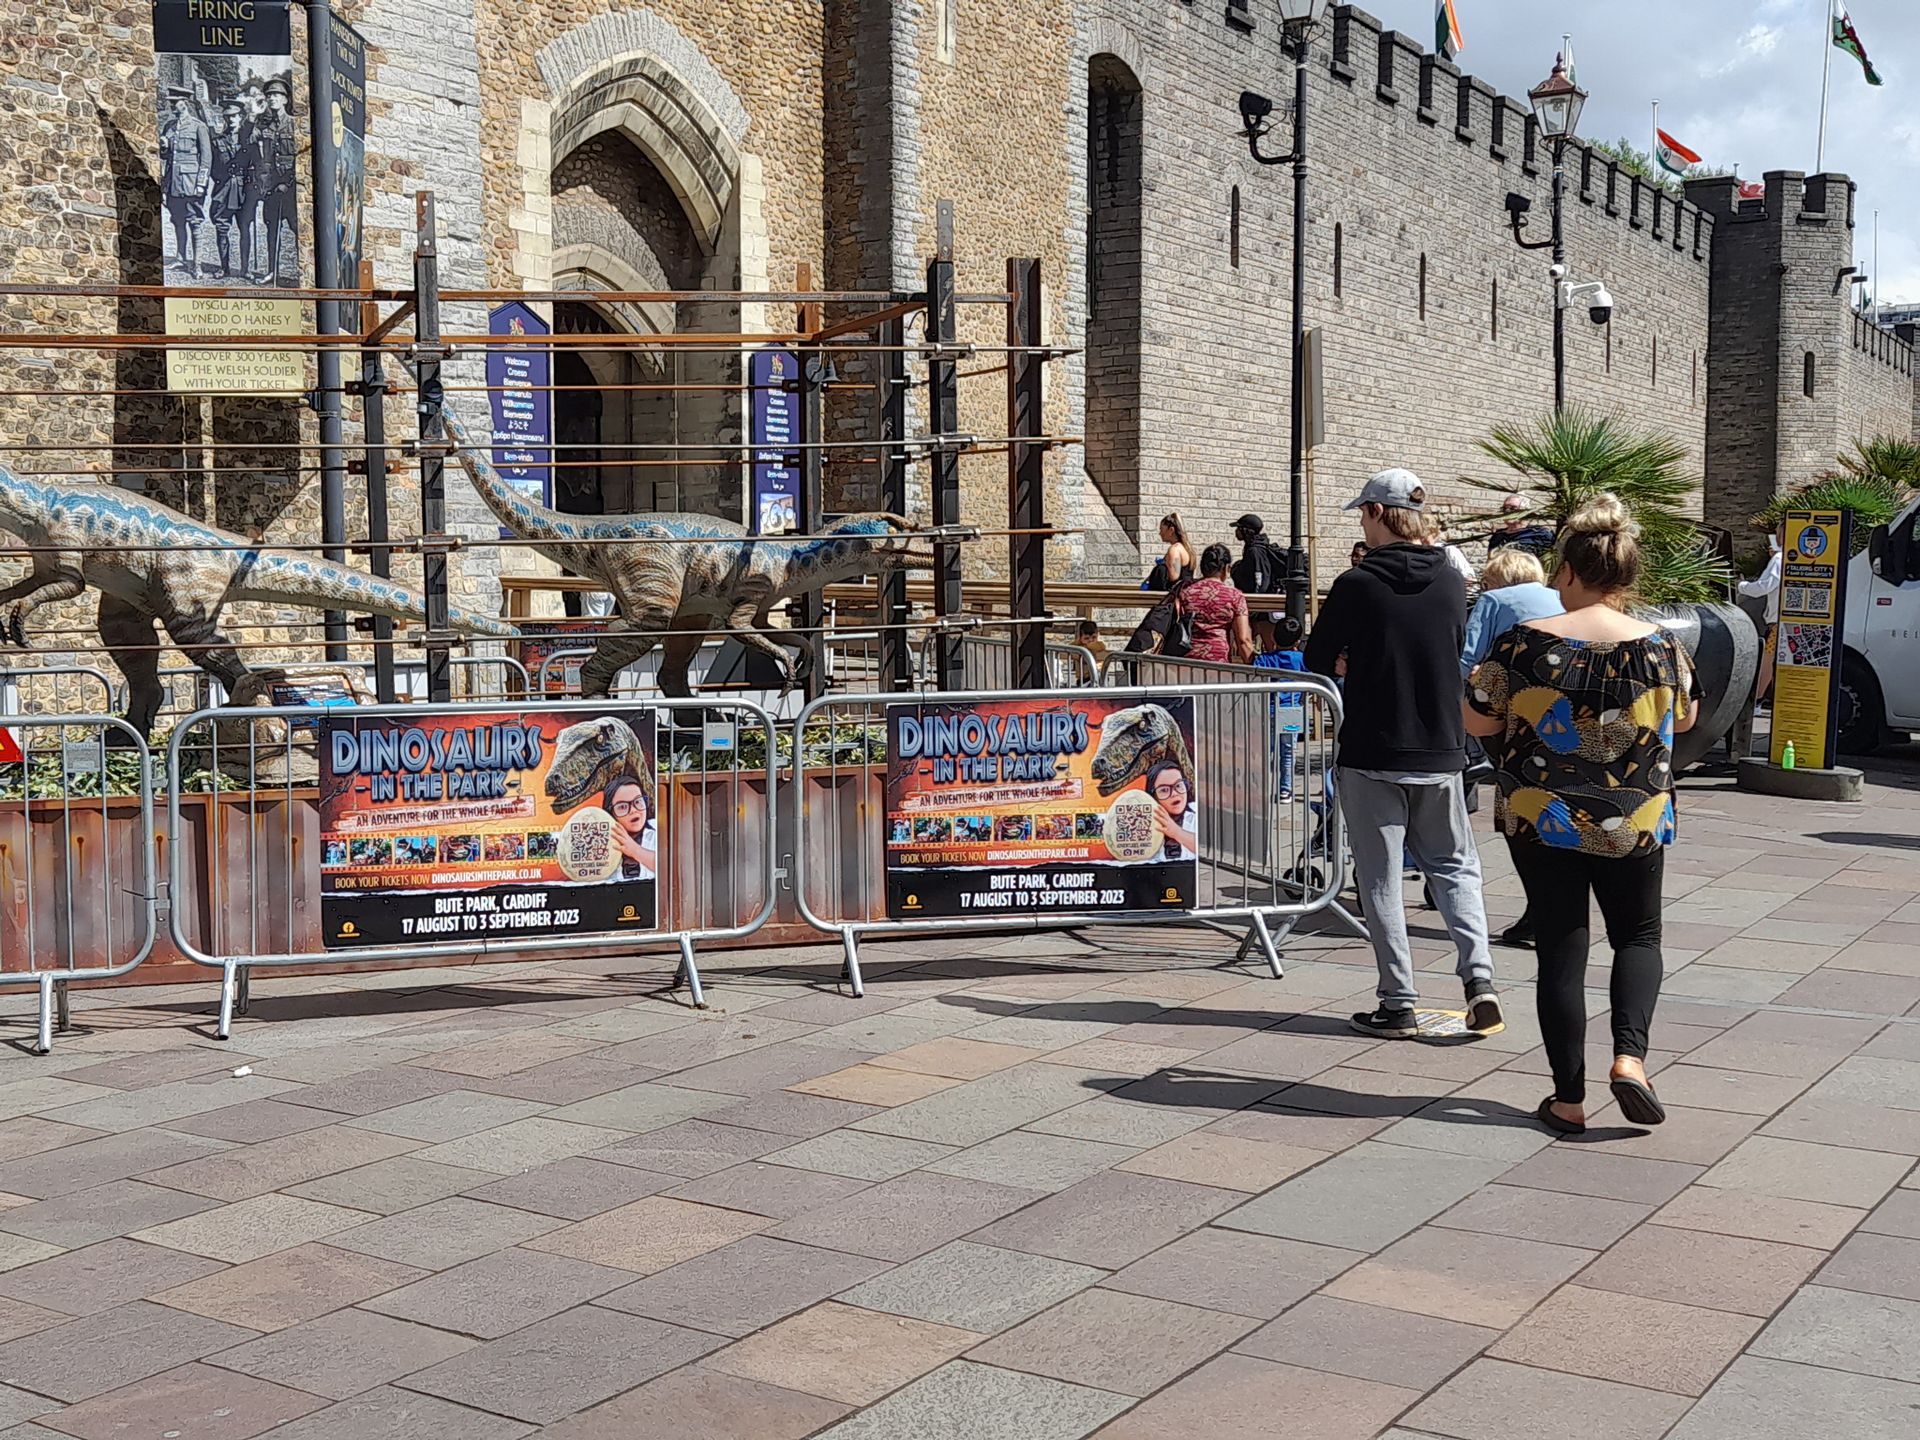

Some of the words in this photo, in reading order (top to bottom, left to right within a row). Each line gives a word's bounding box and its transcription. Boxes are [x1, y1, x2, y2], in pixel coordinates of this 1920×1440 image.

[188, 0, 254, 20] FIRING
[201, 27, 245, 46] LINE
[192, 300, 228, 310] DYSGU
[231, 301, 251, 310] AM
[254, 301, 275, 311] 300
[175, 313, 228, 324] MLYNEDD
[231, 315, 241, 325] O
[245, 315, 282, 325] HANES
[283, 316, 291, 325] Y
[178, 351, 232, 361] DISCOVER
[235, 352, 255, 362] 300
[257, 352, 291, 362] YEARS
[173, 364, 189, 374] OF
[191, 365, 212, 374] THE
[215, 365, 251, 375] WELSH
[254, 366, 297, 376] SOLDIER
[184, 378, 213, 388] WITH
[215, 379, 247, 389] YOUR
[249, 379, 287, 389] TICKET
[897, 712, 1090, 758] DINOSAURS
[331, 725, 543, 775] DINOSAURS
[933, 757, 956, 783] IN
[960, 756, 998, 781] THE
[1003, 754, 1057, 780] PARK
[371, 774, 396, 801] IN
[401, 773, 442, 800] THE
[449, 771, 507, 798] PARK
[920, 795, 931, 806] AN
[933, 792, 977, 805] ADVENTURE
[979, 791, 994, 801] FOR
[995, 790, 1013, 800] THE
[1014, 788, 1039, 799] WHOLE
[371, 811, 420, 826] ADVENTURE
[422, 810, 439, 821] FOR
[441, 807, 458, 819] THE
[459, 805, 488, 818] WHOLE
[901, 854, 920, 864] BOOK
[921, 853, 940, 863] YOUR
[941, 851, 967, 863] TICKETS
[968, 850, 986, 861] NOW
[987, 847, 1089, 861] DINOSAURSINTHEPARK.CO.UK
[335, 878, 357, 889] BOOK
[358, 876, 380, 888] YOUR
[381, 875, 410, 887] TICKETS
[411, 874, 430, 885] NOW
[431, 868, 542, 884] DINOSAURSINTHEPARK.CO.UK
[990, 875, 1016, 889] BUTE
[1018, 874, 1050, 889] PARK,
[1052, 873, 1095, 888] CARDIFF
[435, 898, 464, 914] BUTE
[466, 895, 500, 913] PARK,
[503, 893, 548, 910] CARDIFF
[960, 893, 970, 907] 17
[972, 892, 1014, 907] AUGUST
[1015, 892, 1029, 906] TO
[1031, 891, 1038, 905] 3
[1039, 889, 1097, 905] SEPTEMBER
[1100, 889, 1124, 904] 2023
[402, 919, 414, 934] 17
[416, 916, 460, 934] AUGUST
[462, 914, 478, 931] TO
[479, 914, 487, 930] 3
[489, 910, 551, 929] SEPTEMBER
[553, 908, 580, 925] 2023
